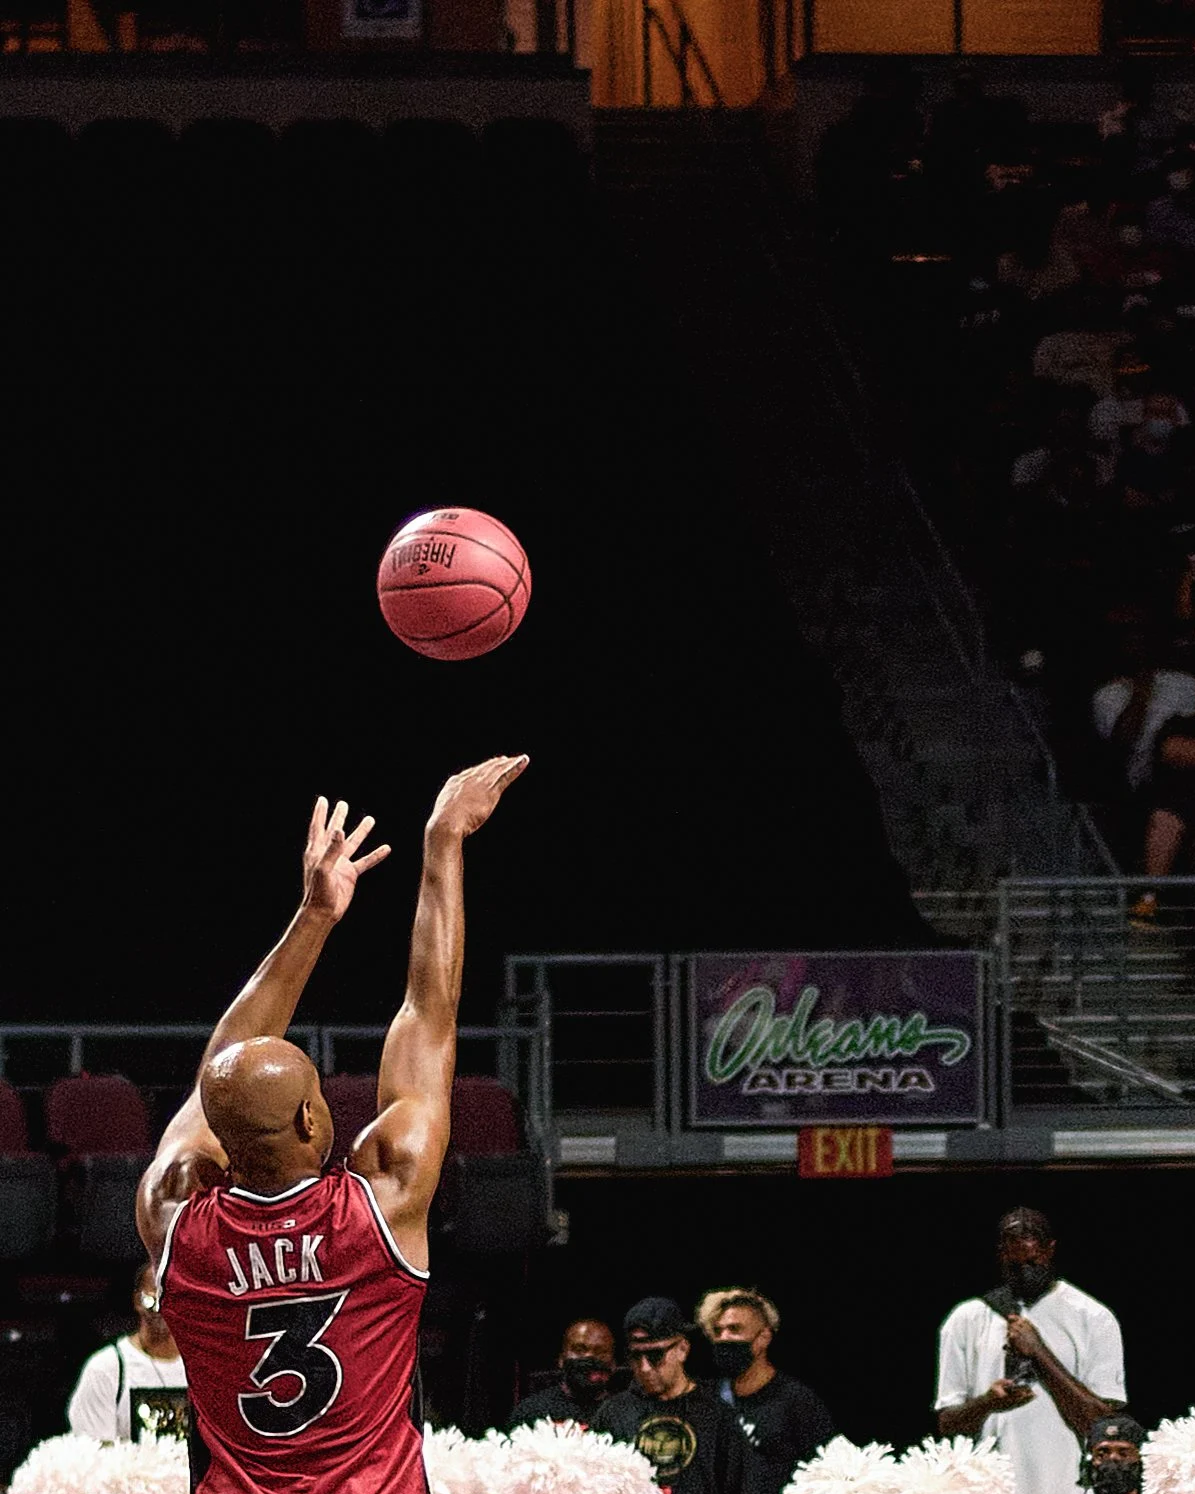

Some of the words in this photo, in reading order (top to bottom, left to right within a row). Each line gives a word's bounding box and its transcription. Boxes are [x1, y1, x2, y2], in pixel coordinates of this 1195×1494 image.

[742, 1069, 935, 1093] ARENA
[813, 1127, 878, 1173] EXIT
[226, 1235, 324, 1296] JACK
[238, 1289, 350, 1437] 3
